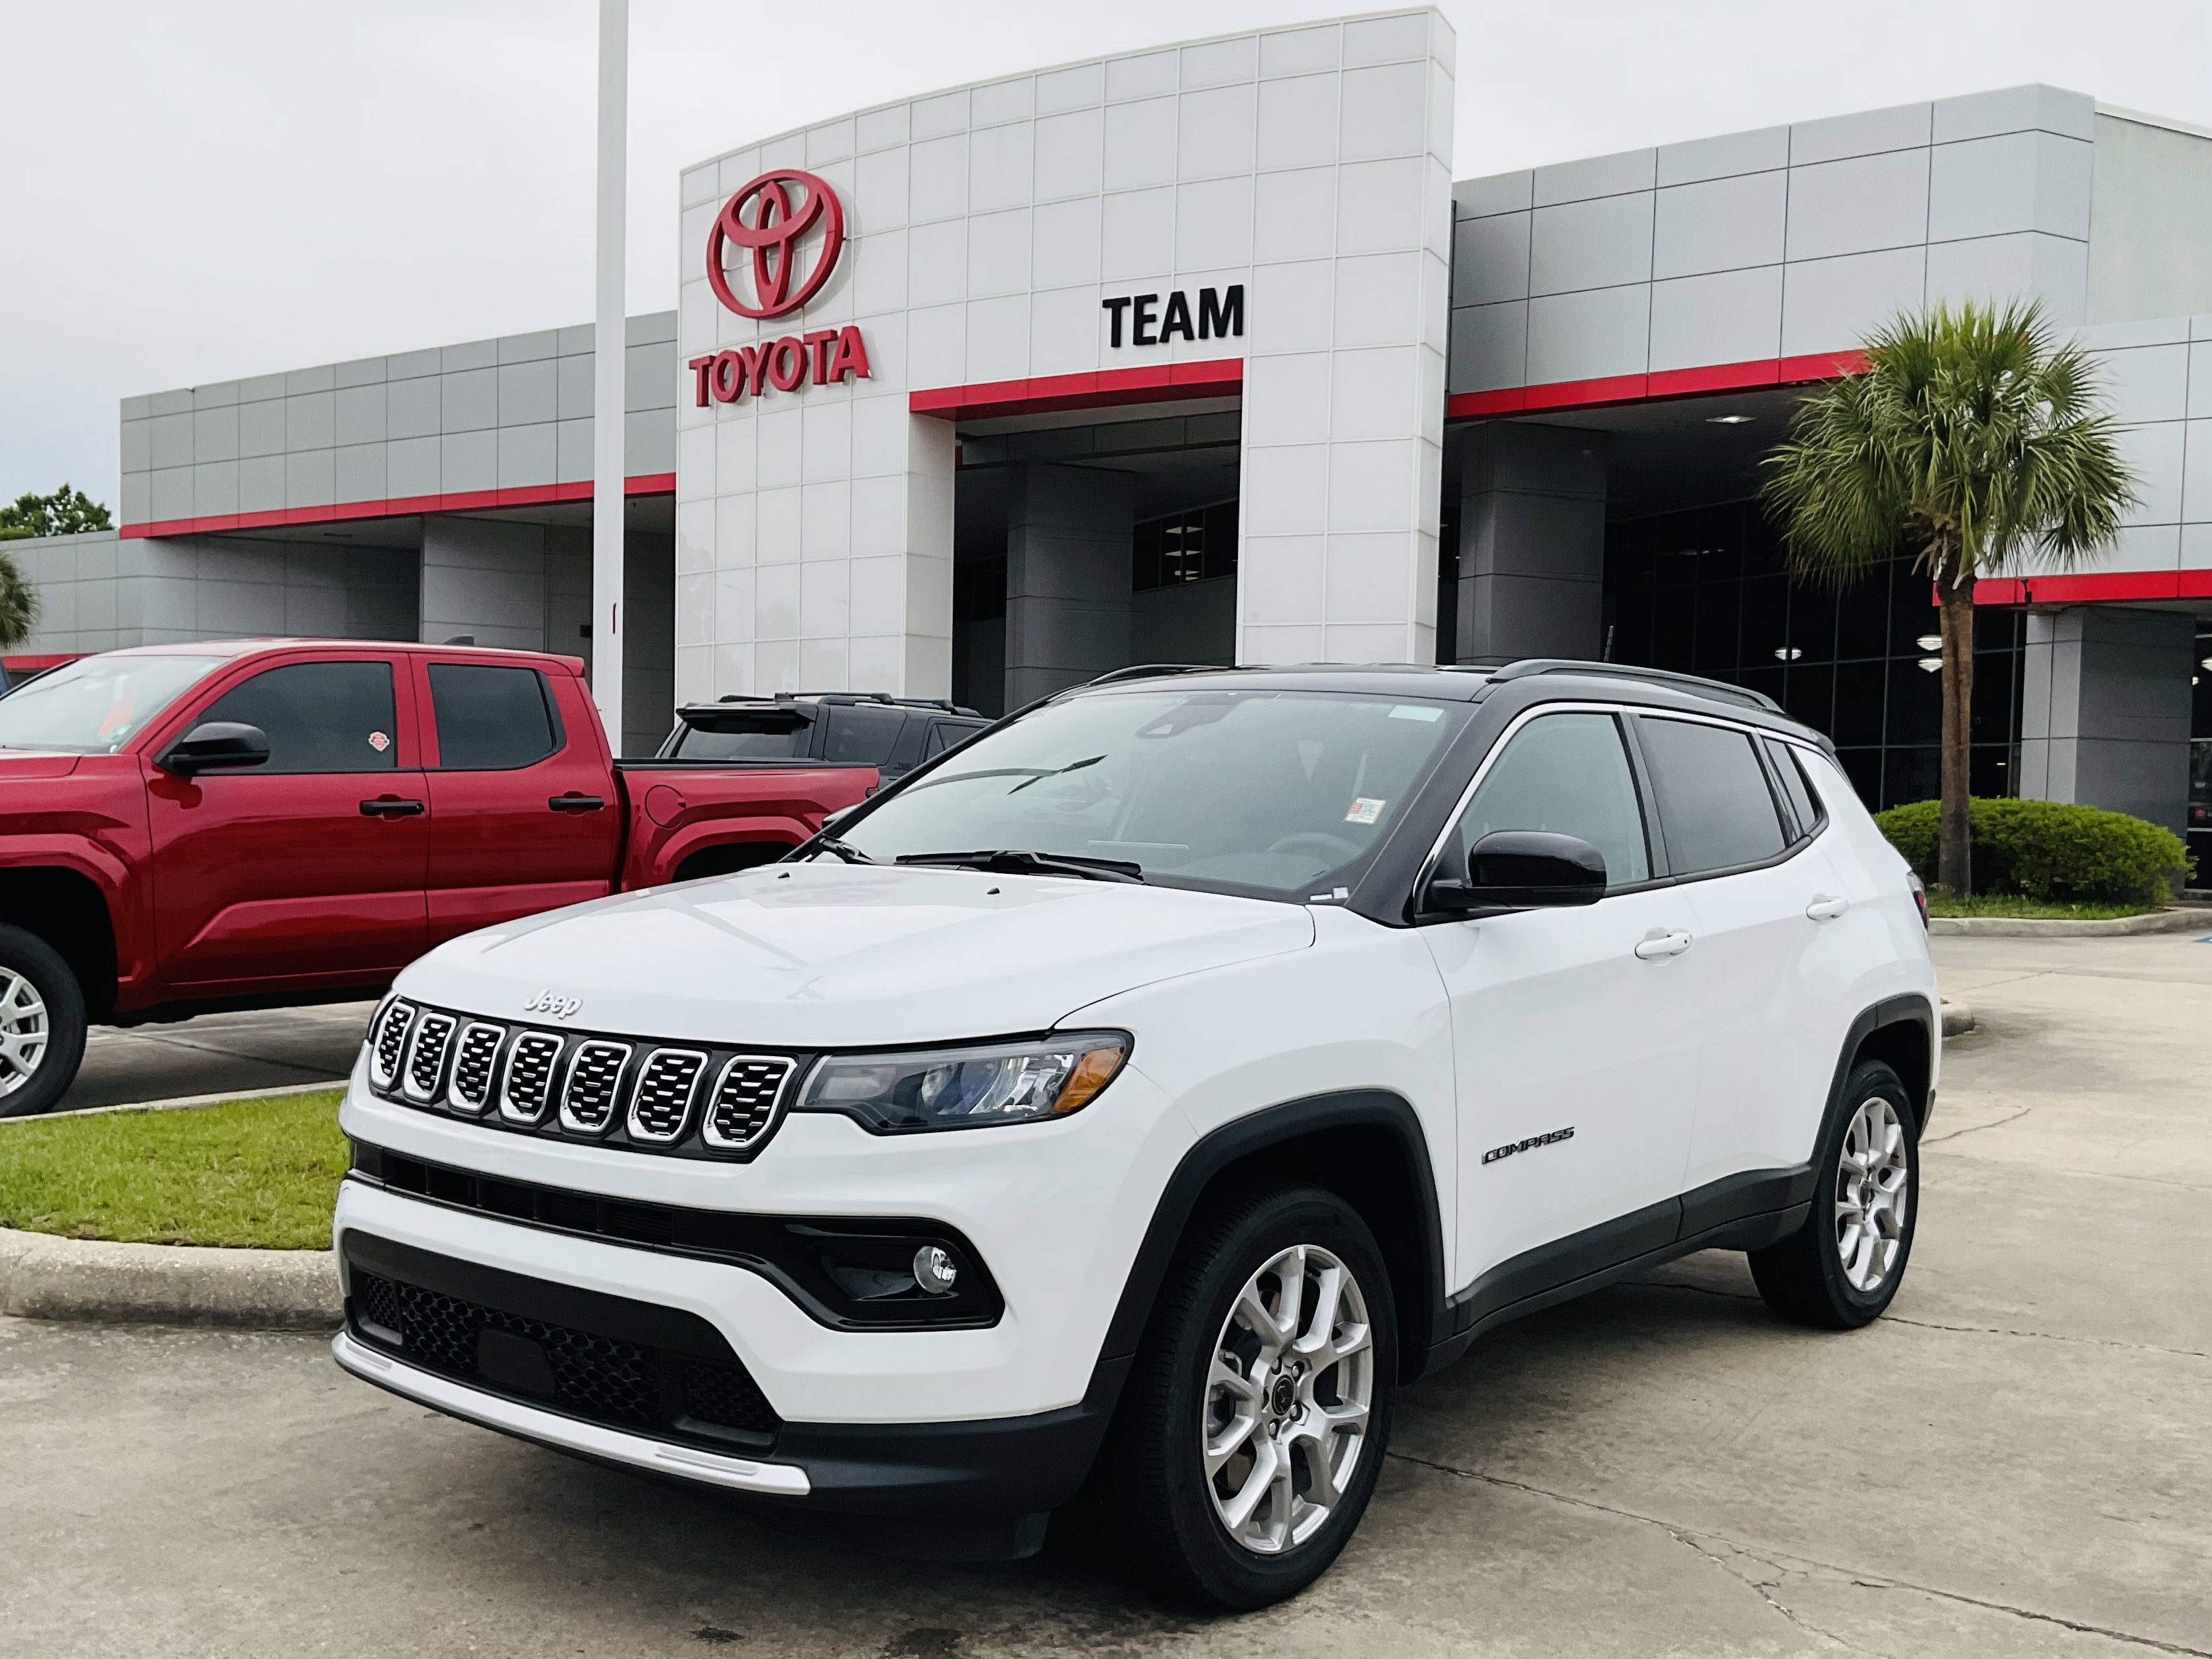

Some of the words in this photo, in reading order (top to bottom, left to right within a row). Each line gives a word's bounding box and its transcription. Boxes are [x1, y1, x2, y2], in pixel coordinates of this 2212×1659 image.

[1102, 284, 1244, 348] TEAM
[689, 325, 871, 407] TOYOTA
[524, 988, 582, 1020] Jeep
[1482, 1126, 1575, 1165] COMPASS
